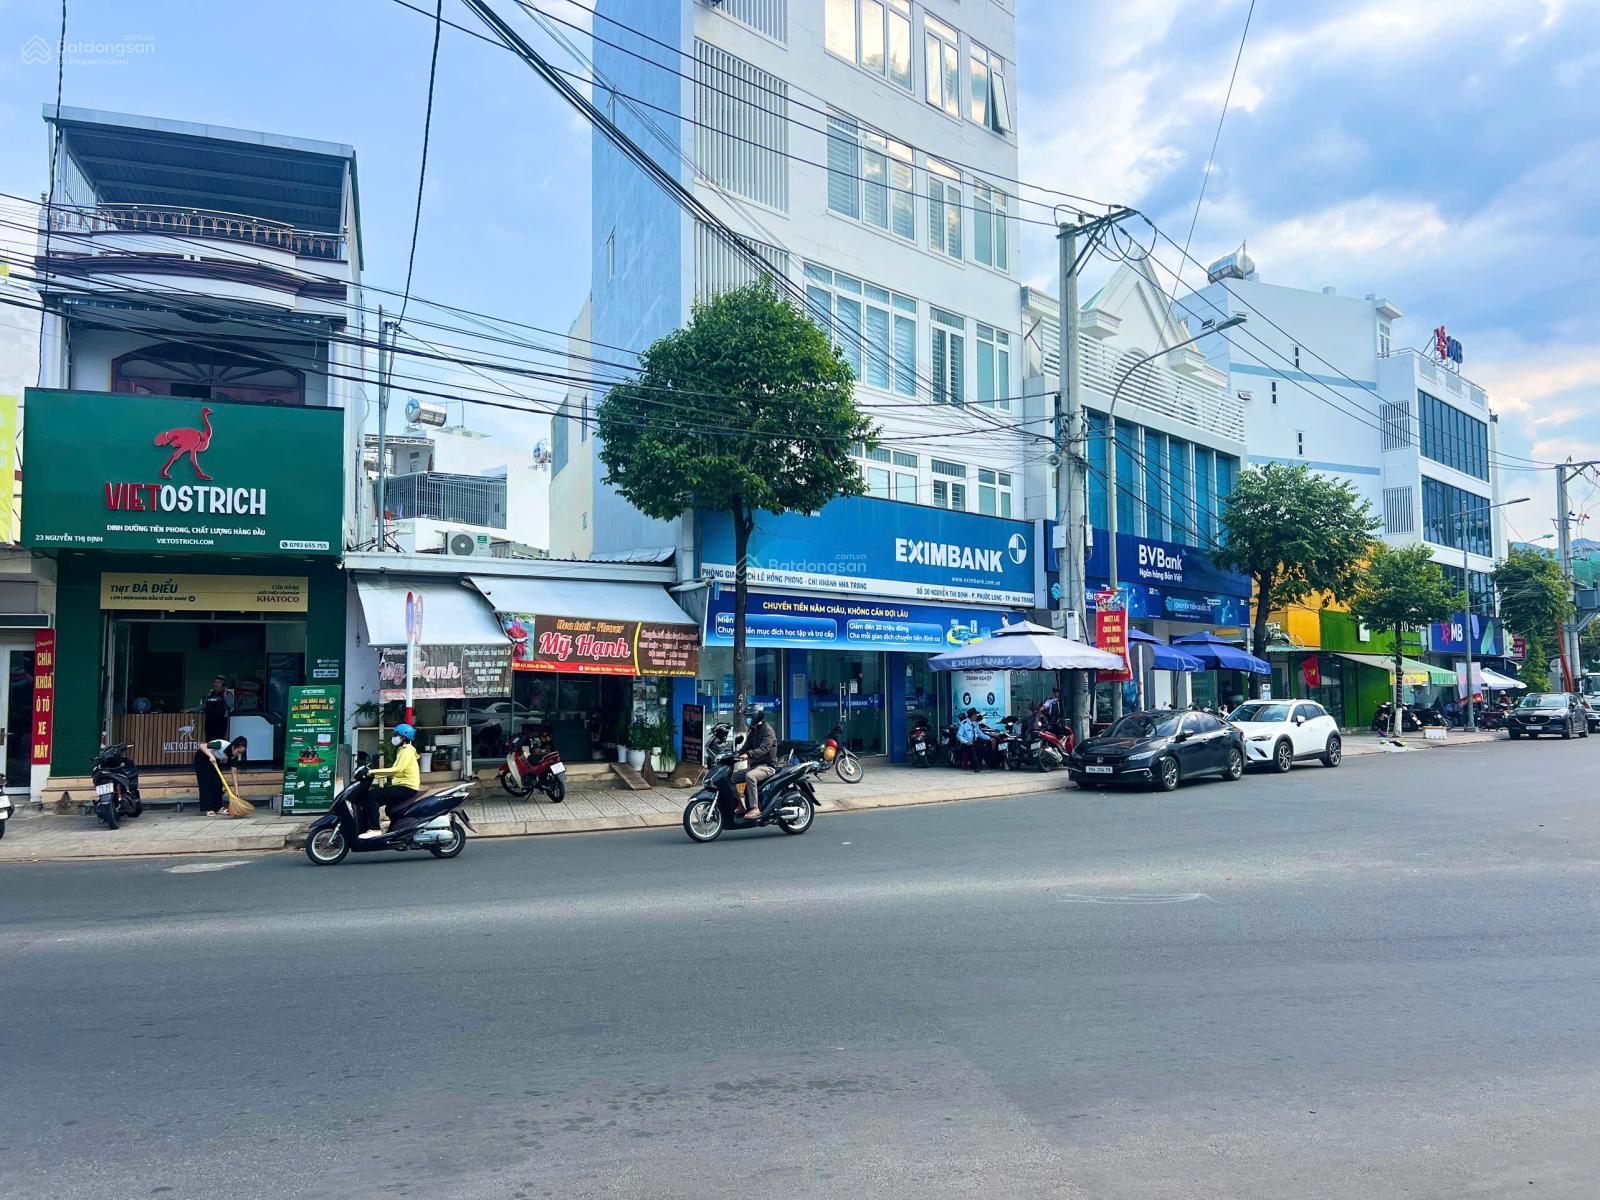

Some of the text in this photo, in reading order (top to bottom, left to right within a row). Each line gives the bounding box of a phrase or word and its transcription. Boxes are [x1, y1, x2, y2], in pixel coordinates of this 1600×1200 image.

[105, 482, 267, 515] VIETOSTRICH
[35, 533, 44, 541] 23
[45, 532, 73, 542] NGUYỄN
[157, 537, 214, 546] VIETOSTRICH.COM
[895, 537, 1004, 573] EXIMBANK
[1139, 543, 1183, 571] BVBank
[702, 567, 724, 579] PHÒNG
[132, 580, 148, 593] ĐÀ
[151, 578, 178, 594] ĐIỂU
[257, 595, 300, 603] KHATOCO
[762, 600, 909, 619] CHUYỂN TIỀN NĂM CHÂU, KHÔNG CẦN ĐỢI LÂU
[756, 628, 770, 637] mục
[771, 628, 784, 636] đích
[785, 629, 797, 639] học
[797, 630, 808, 640] tập
[808, 630, 815, 638] và
[824, 630, 835, 641] cấp
[848, 622, 909, 634] Giảm đến 20 triệu đồng
[1451, 623, 1463, 641] MB
[848, 632, 860, 640] Cho
[871, 634, 883, 642] giao
[883, 634, 895, 642] dịch
[895, 634, 913, 644] chuyển
[539, 631, 631, 661] Mỹ Hạnh
[951, 656, 1004, 669] EXIMBANK
[38, 721, 47, 735] XE
[34, 742, 49, 759] MÁY
